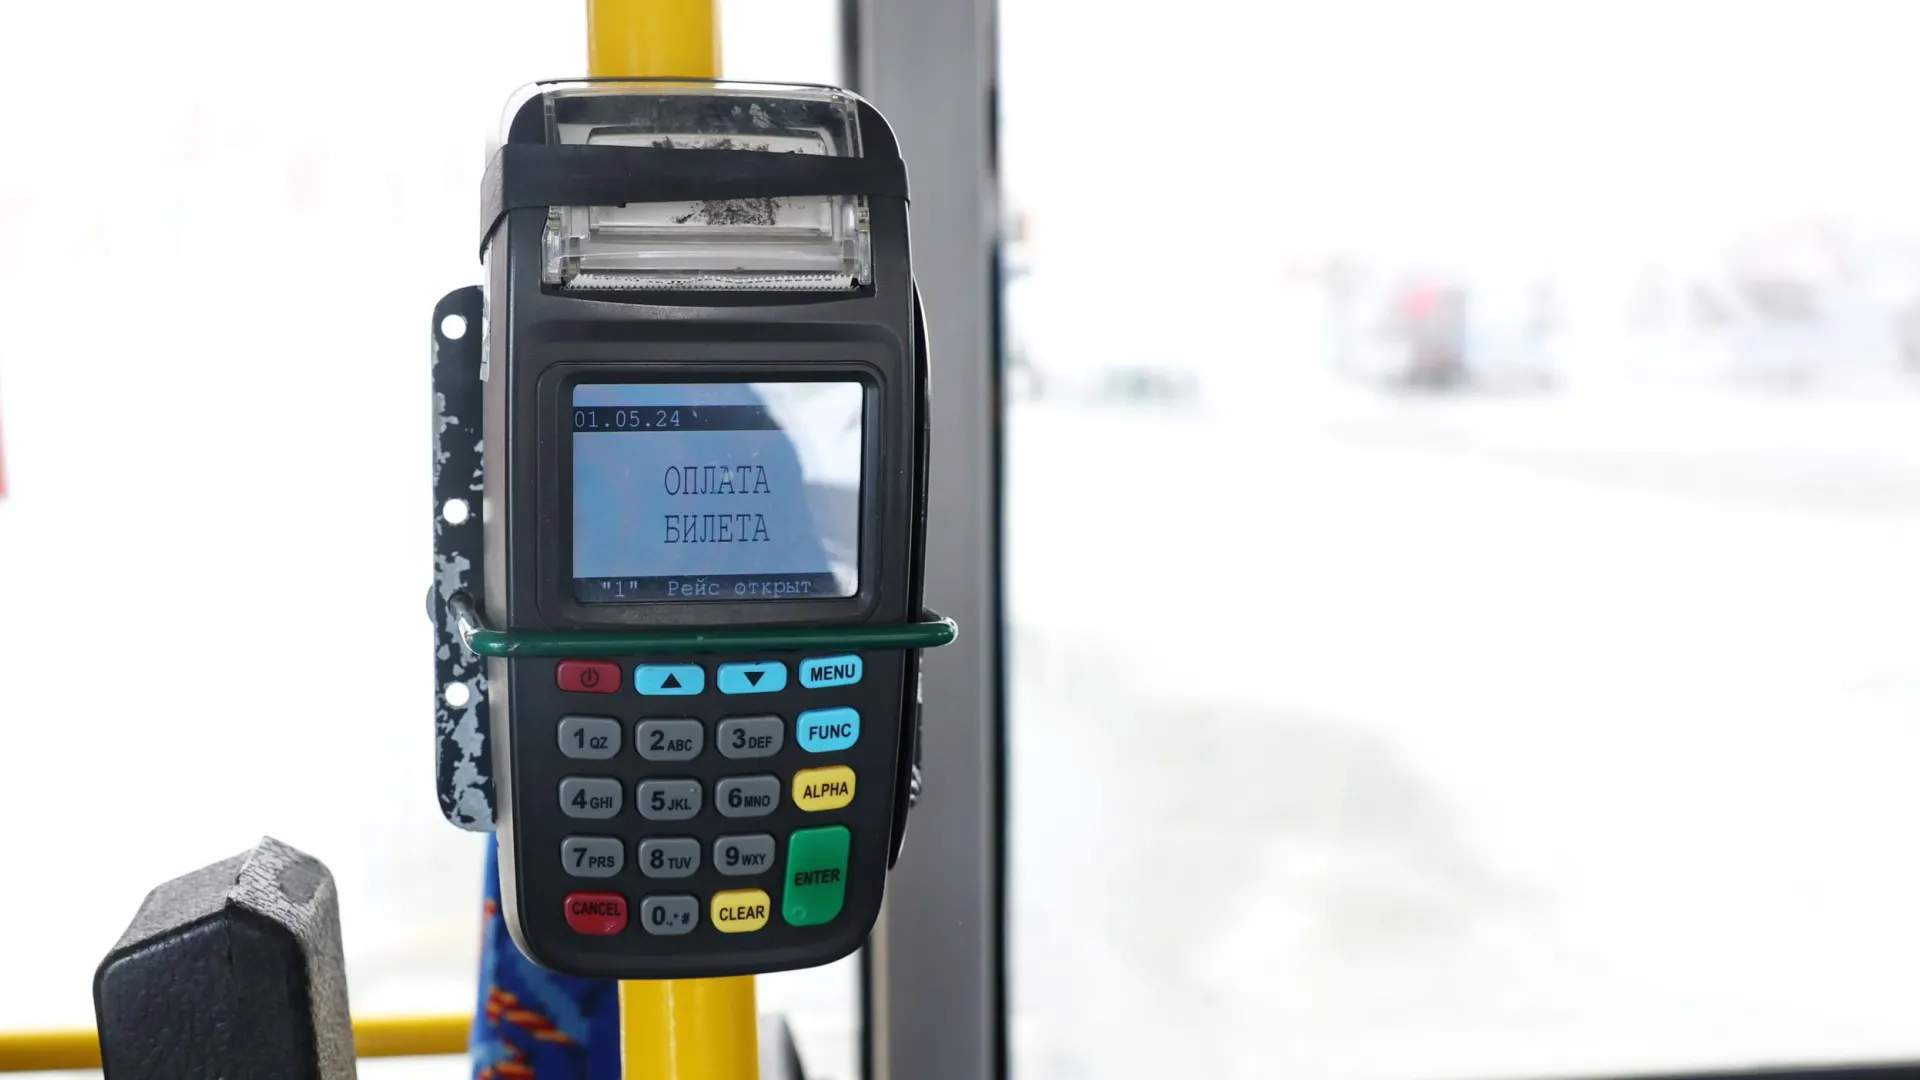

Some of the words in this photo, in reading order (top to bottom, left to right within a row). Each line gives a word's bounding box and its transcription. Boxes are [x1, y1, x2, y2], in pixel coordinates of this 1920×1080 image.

[574, 410, 681, 428] 01.05.24
[664, 465, 771, 495] ОПЛАТА
[664, 513, 770, 543] БИЛЕТА
[668, 577, 720, 596] Рейс
[734, 580, 812, 598] открыт
[810, 663, 855, 682] MENU
[808, 722, 852, 741] FUNC
[802, 781, 849, 799] ALPHA
[794, 868, 841, 886] ENTER
[572, 901, 621, 917] CANCEL
[719, 905, 765, 922] CLEAR
